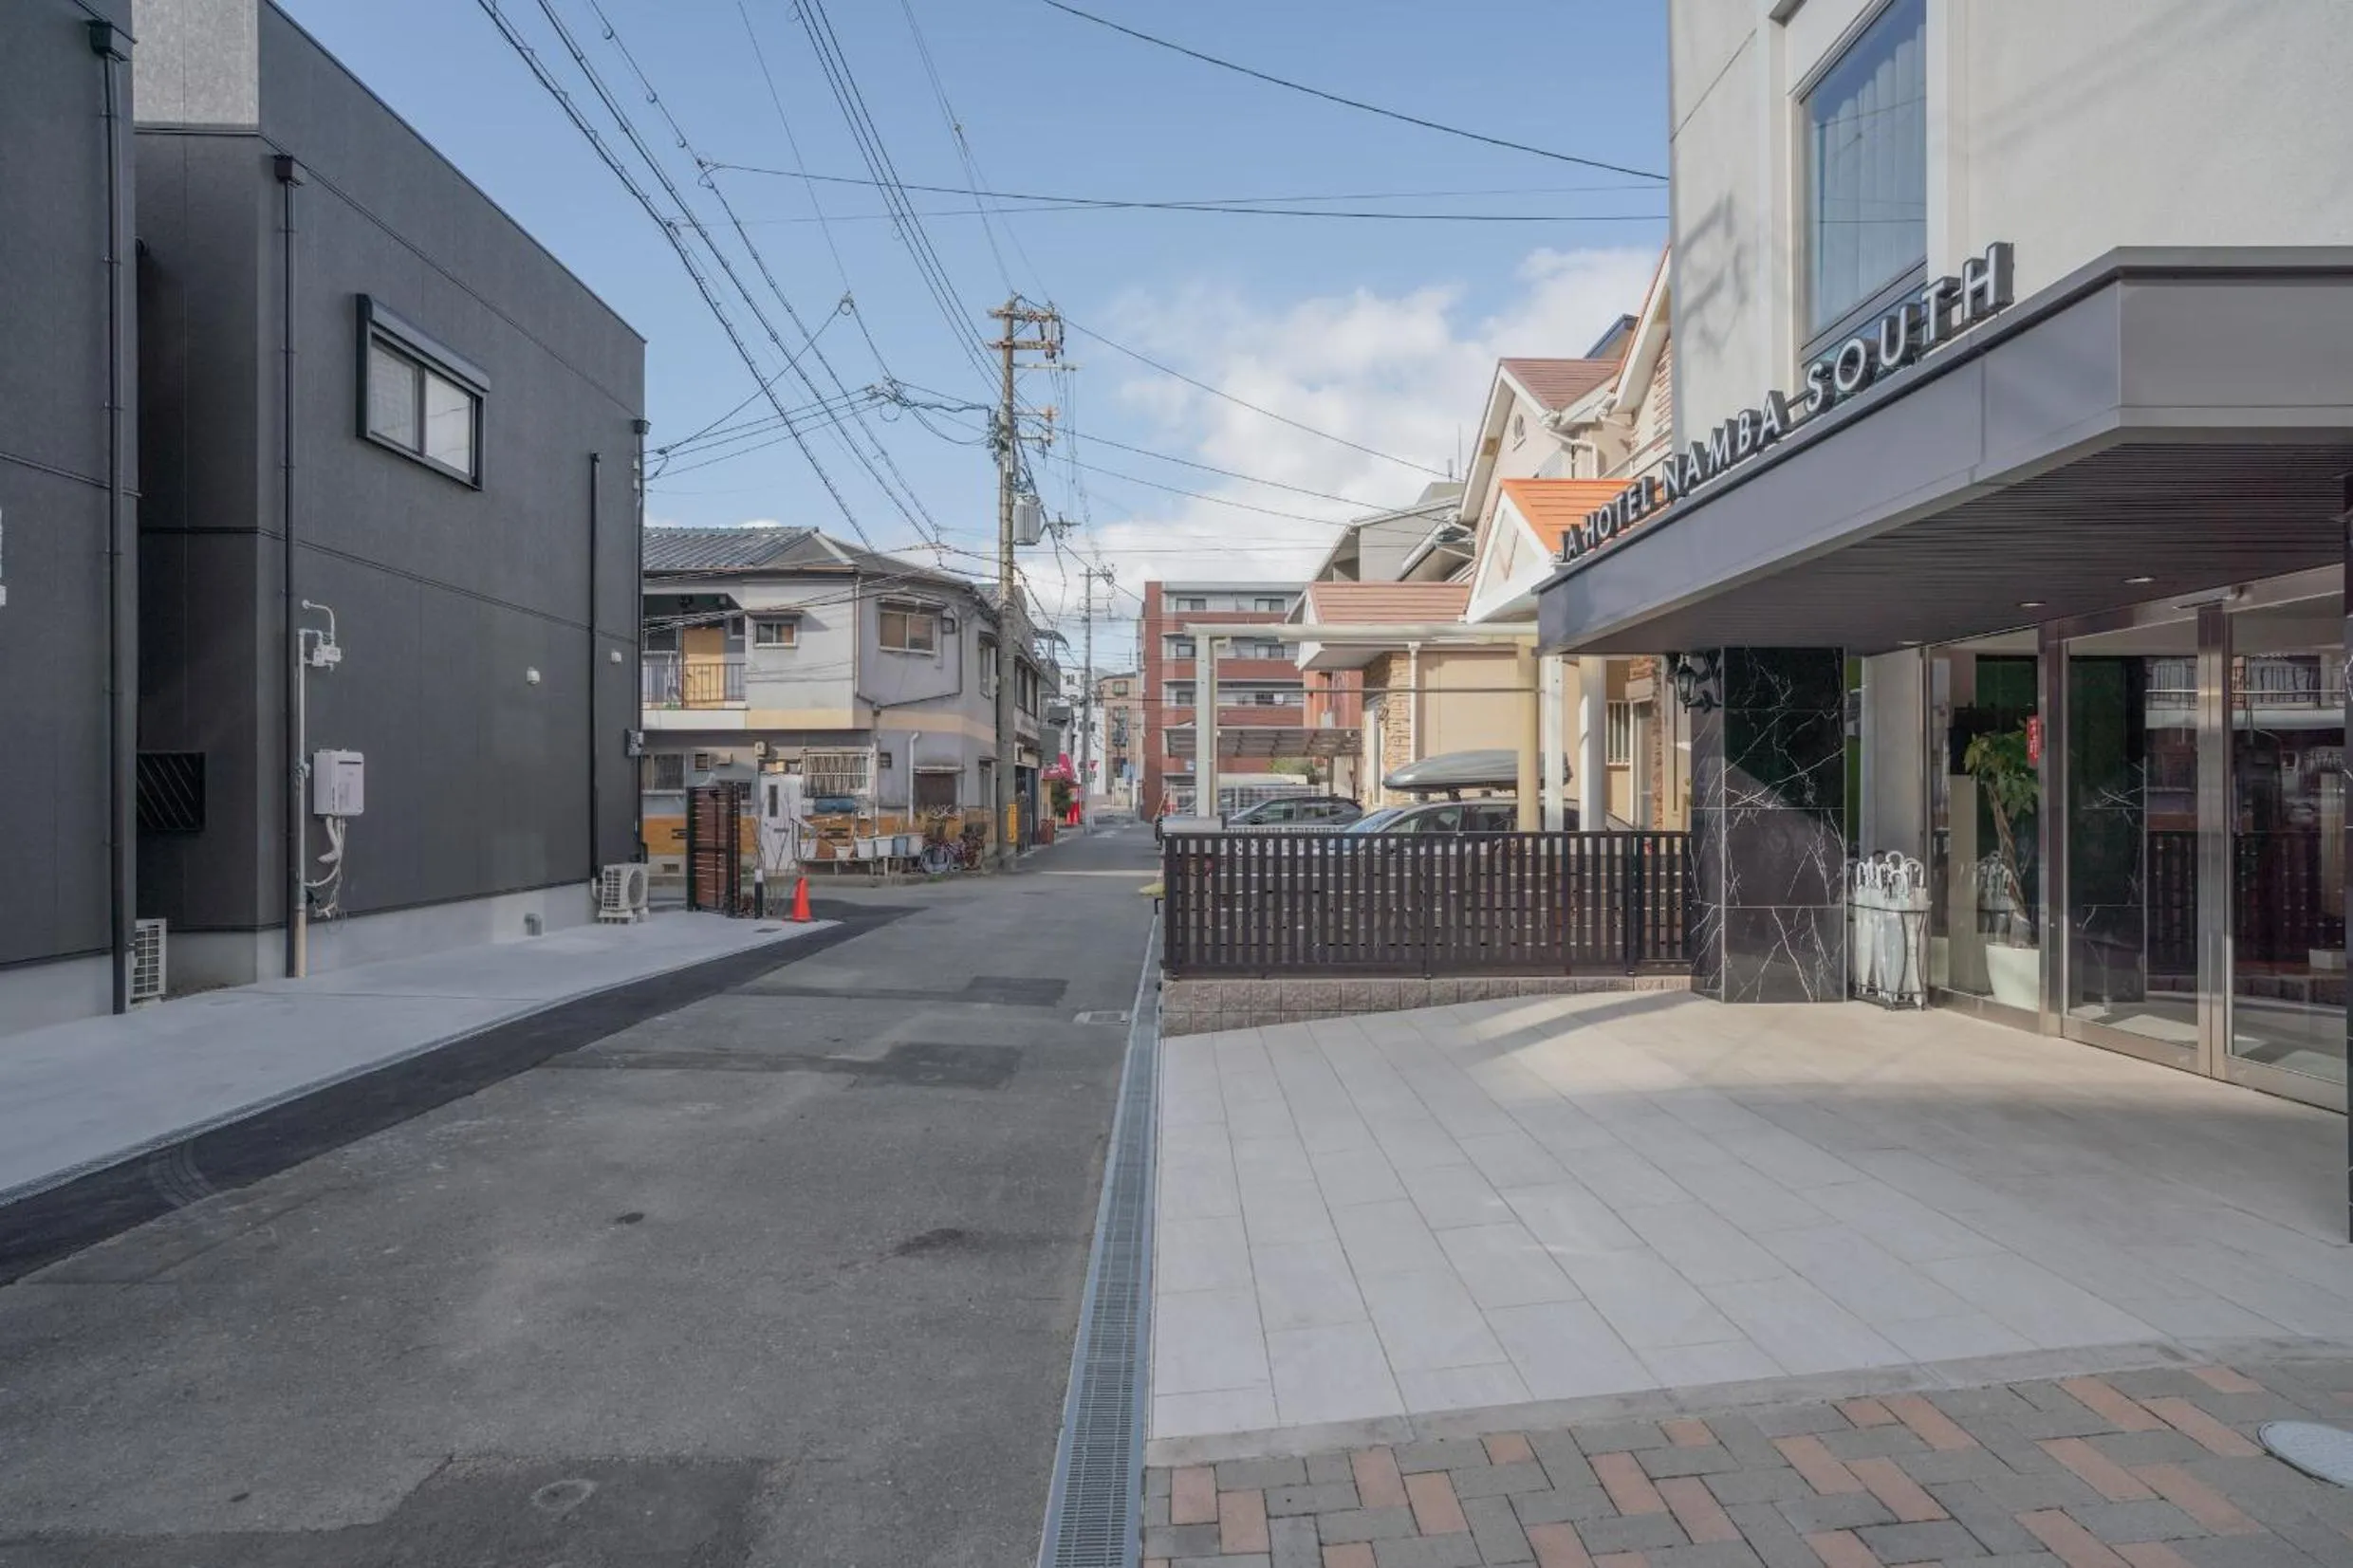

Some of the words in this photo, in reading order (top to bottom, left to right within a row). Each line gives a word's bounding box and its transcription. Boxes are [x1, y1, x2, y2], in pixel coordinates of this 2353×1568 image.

[1583, 476, 1654, 547] HOTEL
[1661, 390, 1789, 501] NAMBA
[1805, 242, 2013, 413] SOUTH
